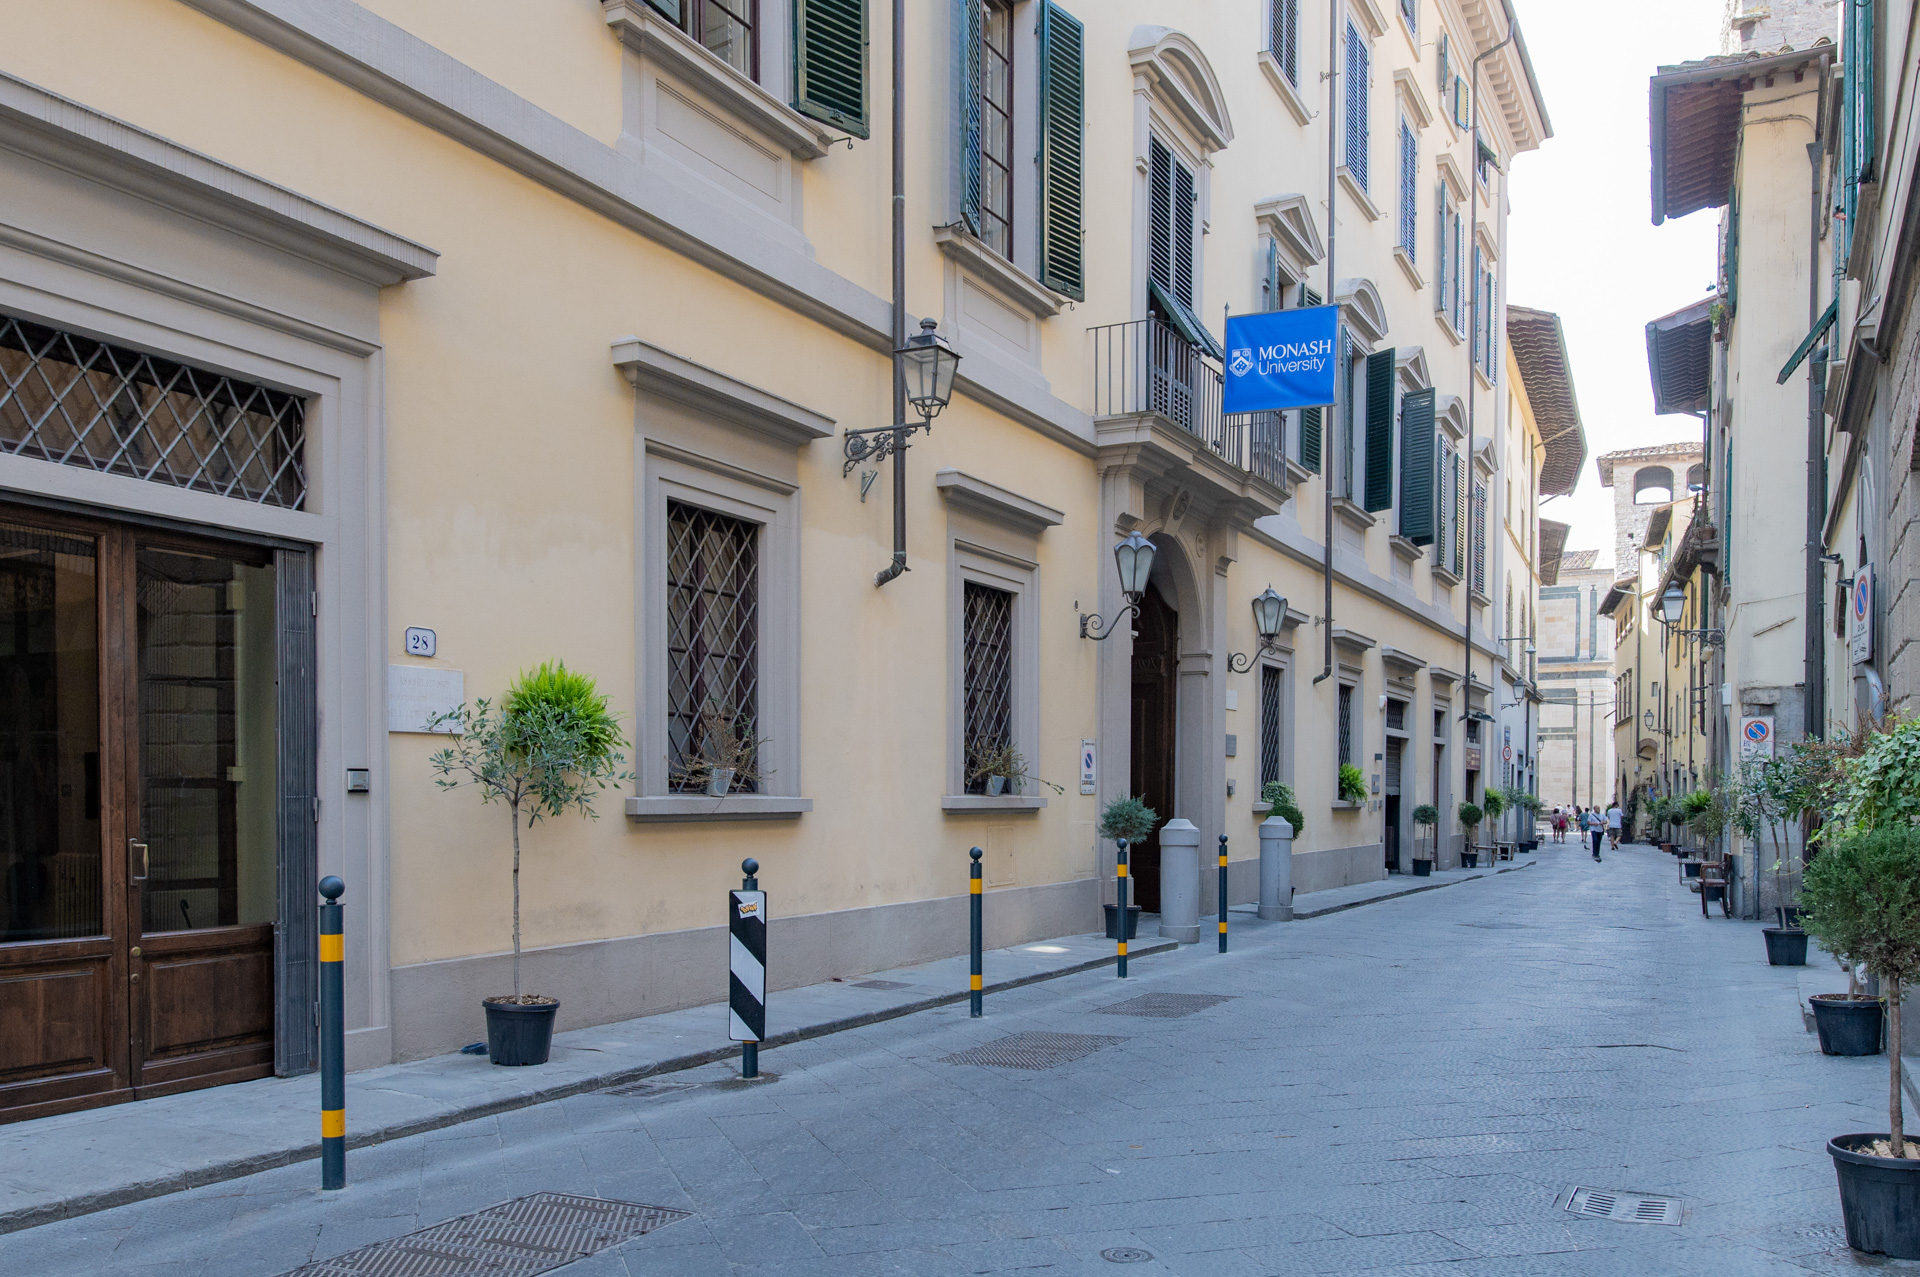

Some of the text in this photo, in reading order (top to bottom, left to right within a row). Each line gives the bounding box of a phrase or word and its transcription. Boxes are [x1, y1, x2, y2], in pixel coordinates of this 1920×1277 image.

[1259, 339, 1332, 360] MONASH
[1258, 356, 1326, 376] University
[412, 634, 429, 650] 28
